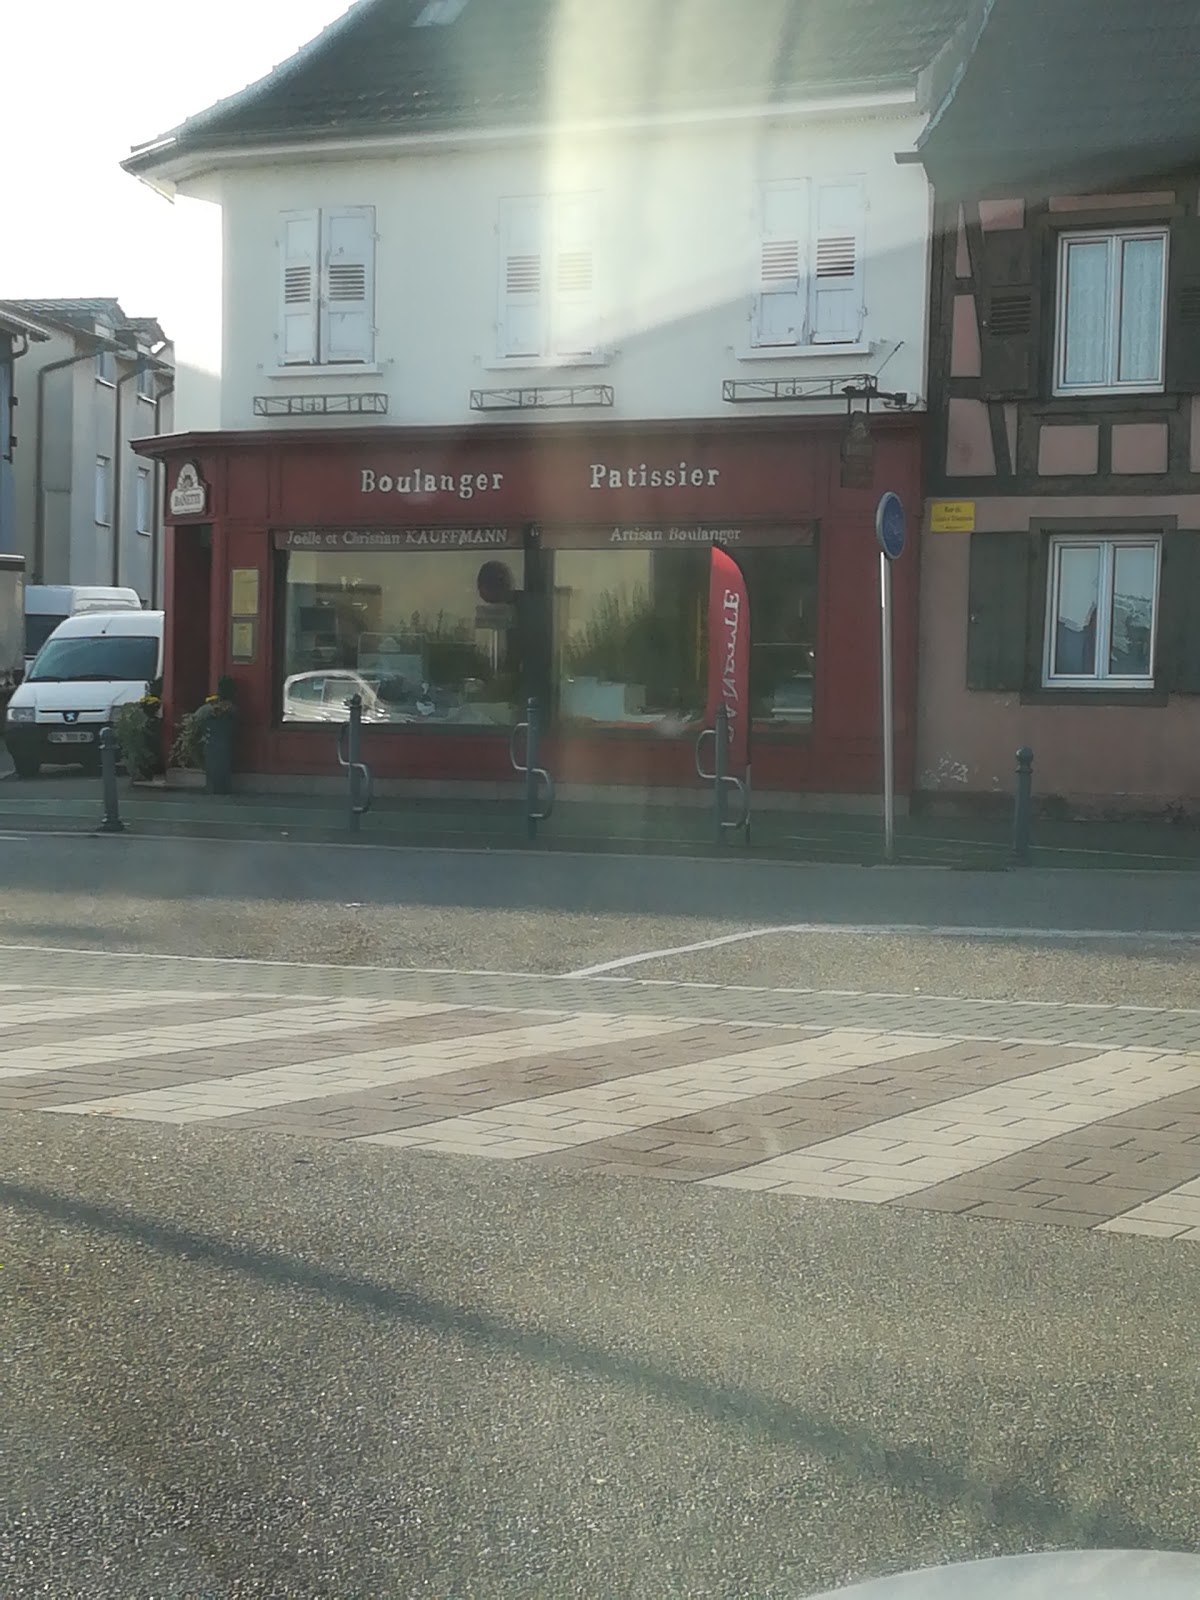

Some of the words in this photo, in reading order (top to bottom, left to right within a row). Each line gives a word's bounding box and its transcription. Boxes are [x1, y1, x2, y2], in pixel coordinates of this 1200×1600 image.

[361, 469, 504, 499] Boulanger
[590, 462, 720, 488] Patissier
[326, 534, 337, 544] et
[342, 530, 400, 544] Christian
[405, 529, 508, 545] KAUFFMANN
[610, 528, 662, 541] Artisan
[669, 528, 741, 544] Boulanger
